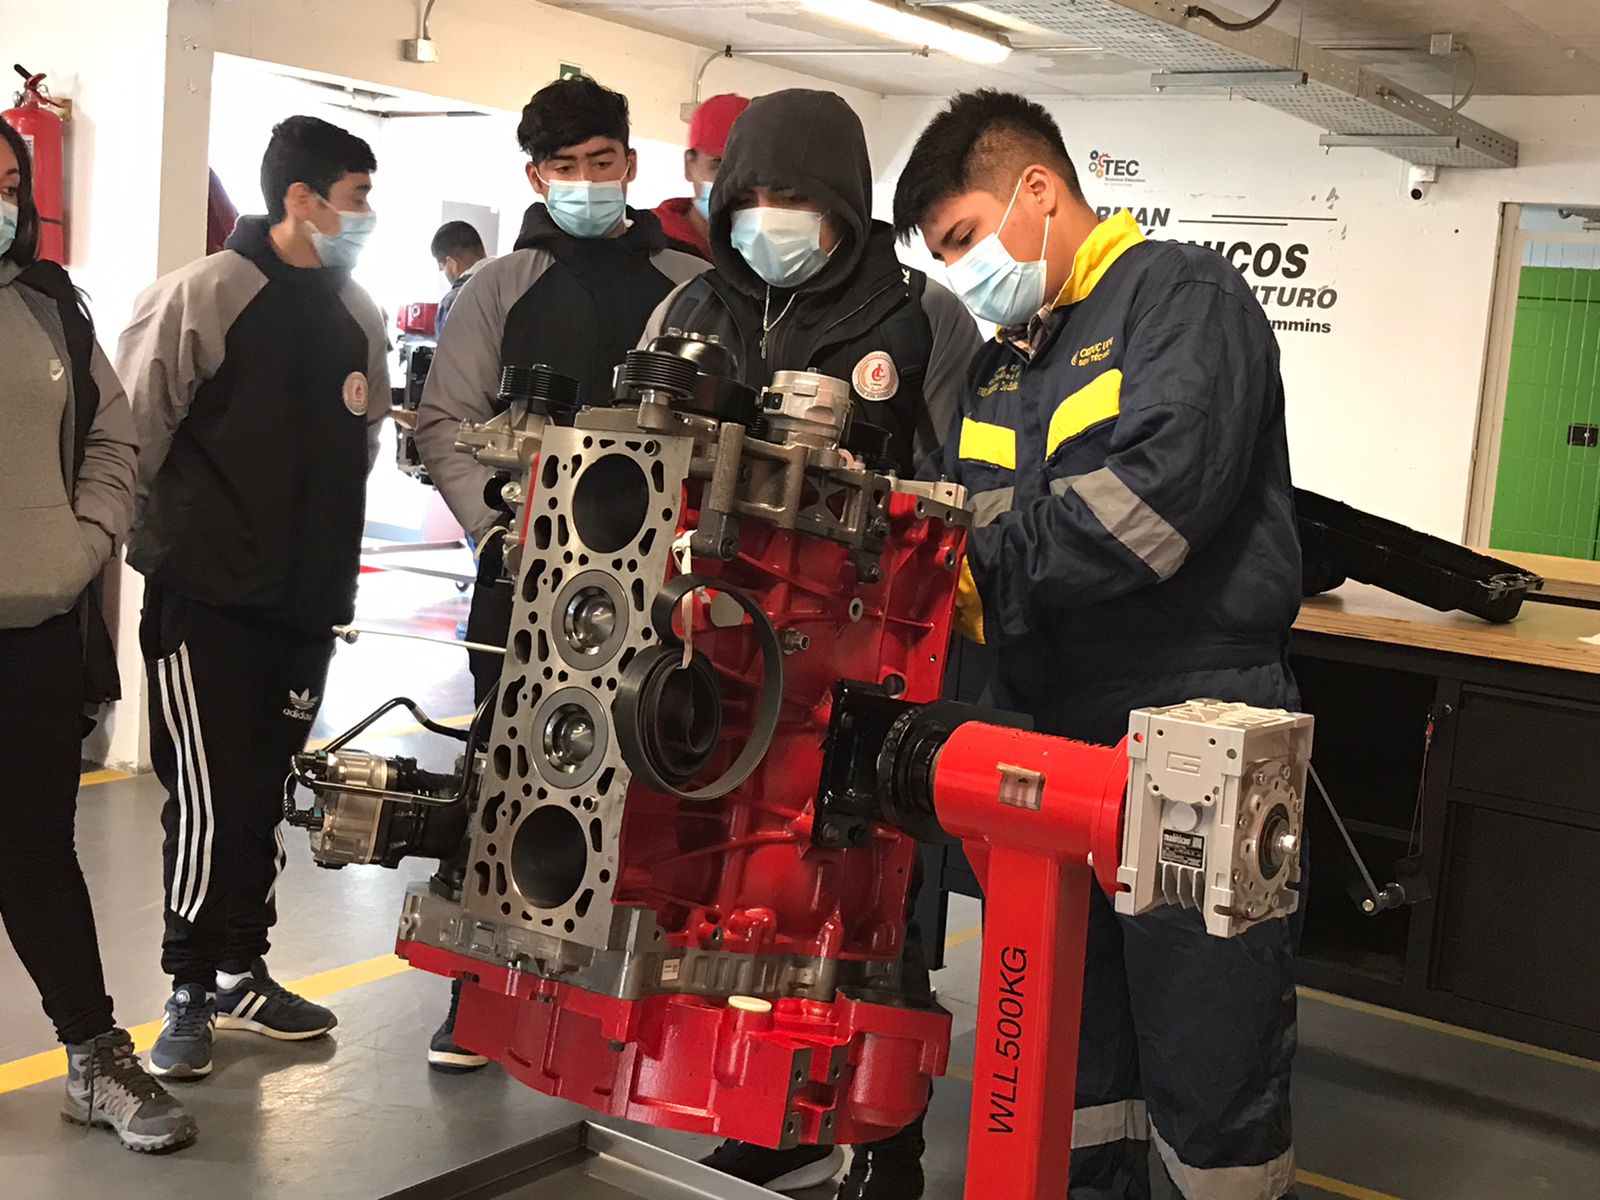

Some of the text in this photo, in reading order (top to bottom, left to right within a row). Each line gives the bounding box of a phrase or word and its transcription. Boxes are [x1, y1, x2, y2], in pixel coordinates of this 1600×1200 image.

[1102, 159, 1140, 177] TEC
[1095, 206, 1171, 227] RAN
[1268, 318, 1332, 334] mmins
[987, 945, 1028, 1134] WLL 500KG
